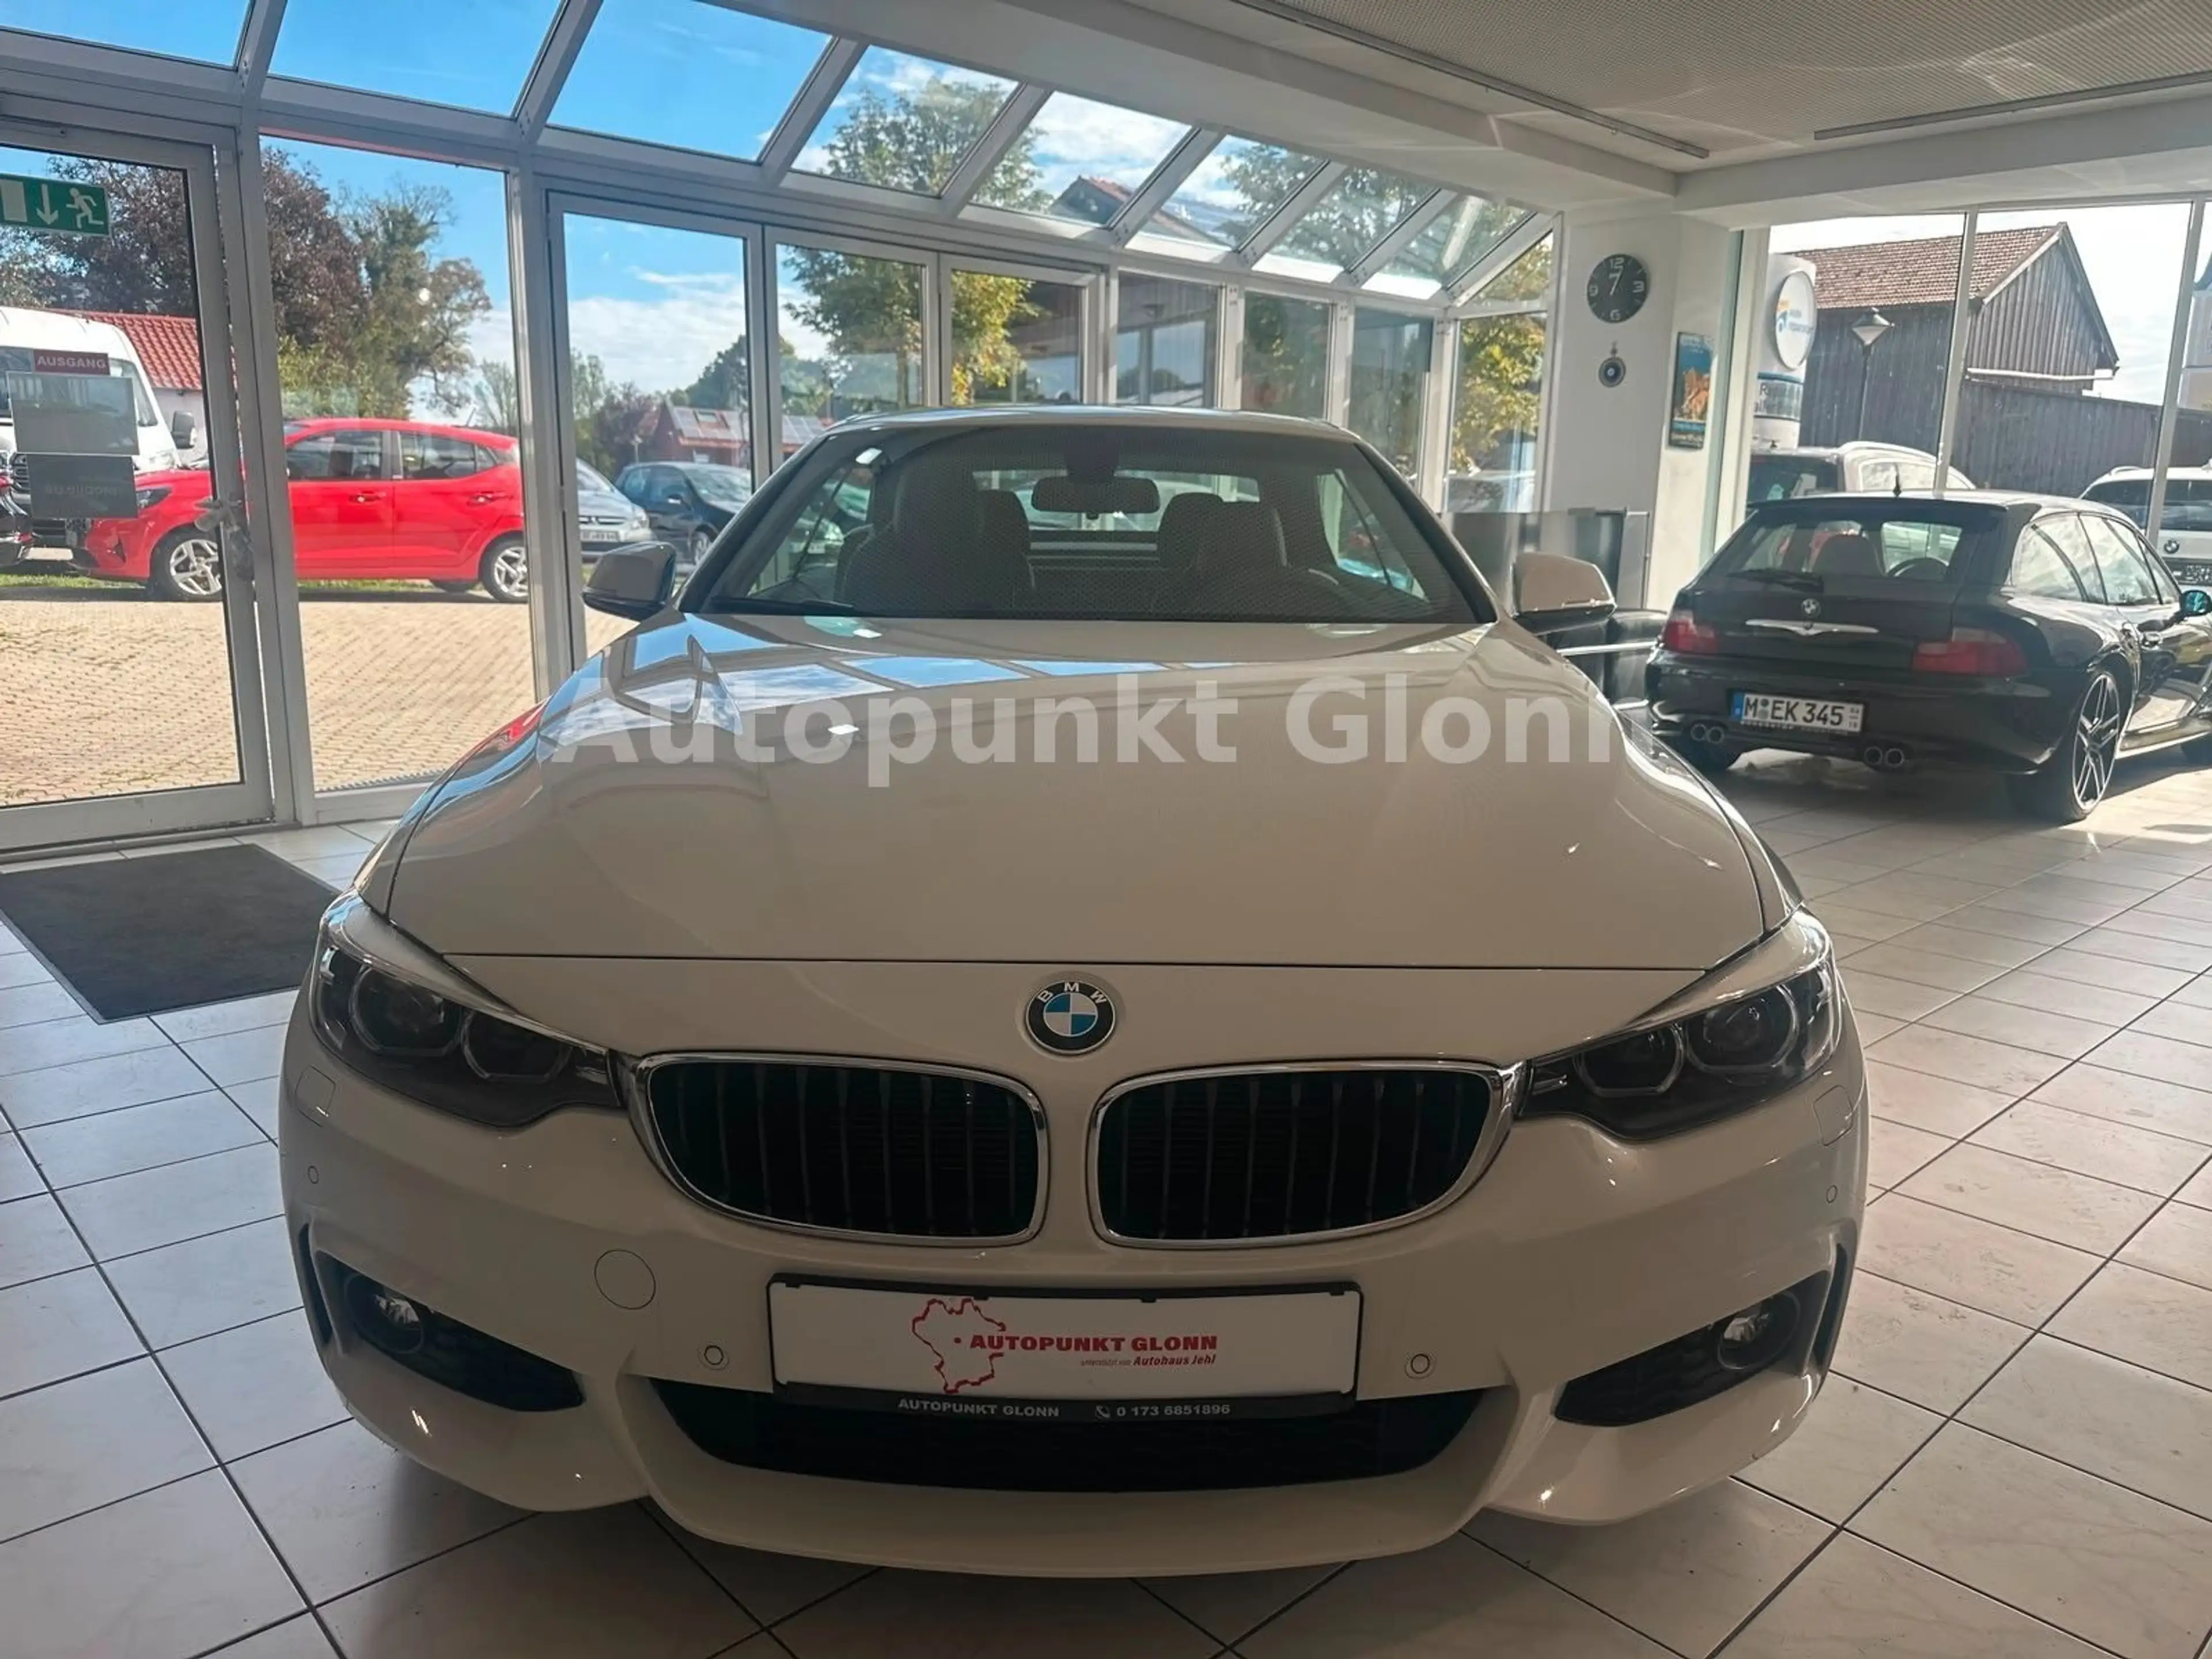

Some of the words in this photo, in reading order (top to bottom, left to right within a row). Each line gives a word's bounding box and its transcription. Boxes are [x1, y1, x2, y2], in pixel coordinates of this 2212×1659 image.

[37, 355, 107, 369] AUSGANG
[1744, 697, 1758, 718] M
[1771, 700, 1799, 722] EK
[1802, 703, 1845, 726] 345
[1037, 982, 1107, 1003] BMW
[970, 1335, 1126, 1351] AUTOPUNKT
[1131, 1335, 1218, 1351] GLONN
[1133, 1355, 1190, 1366] Autohaus
[1191, 1354, 1216, 1365] Jehl
[898, 1398, 998, 1414] AUTOPUNKT
[1003, 1405, 1059, 1416] GLONN
[1116, 1406, 1126, 1416] 0
[1131, 1406, 1160, 1416] 173
[1164, 1404, 1231, 1415] 6851896
